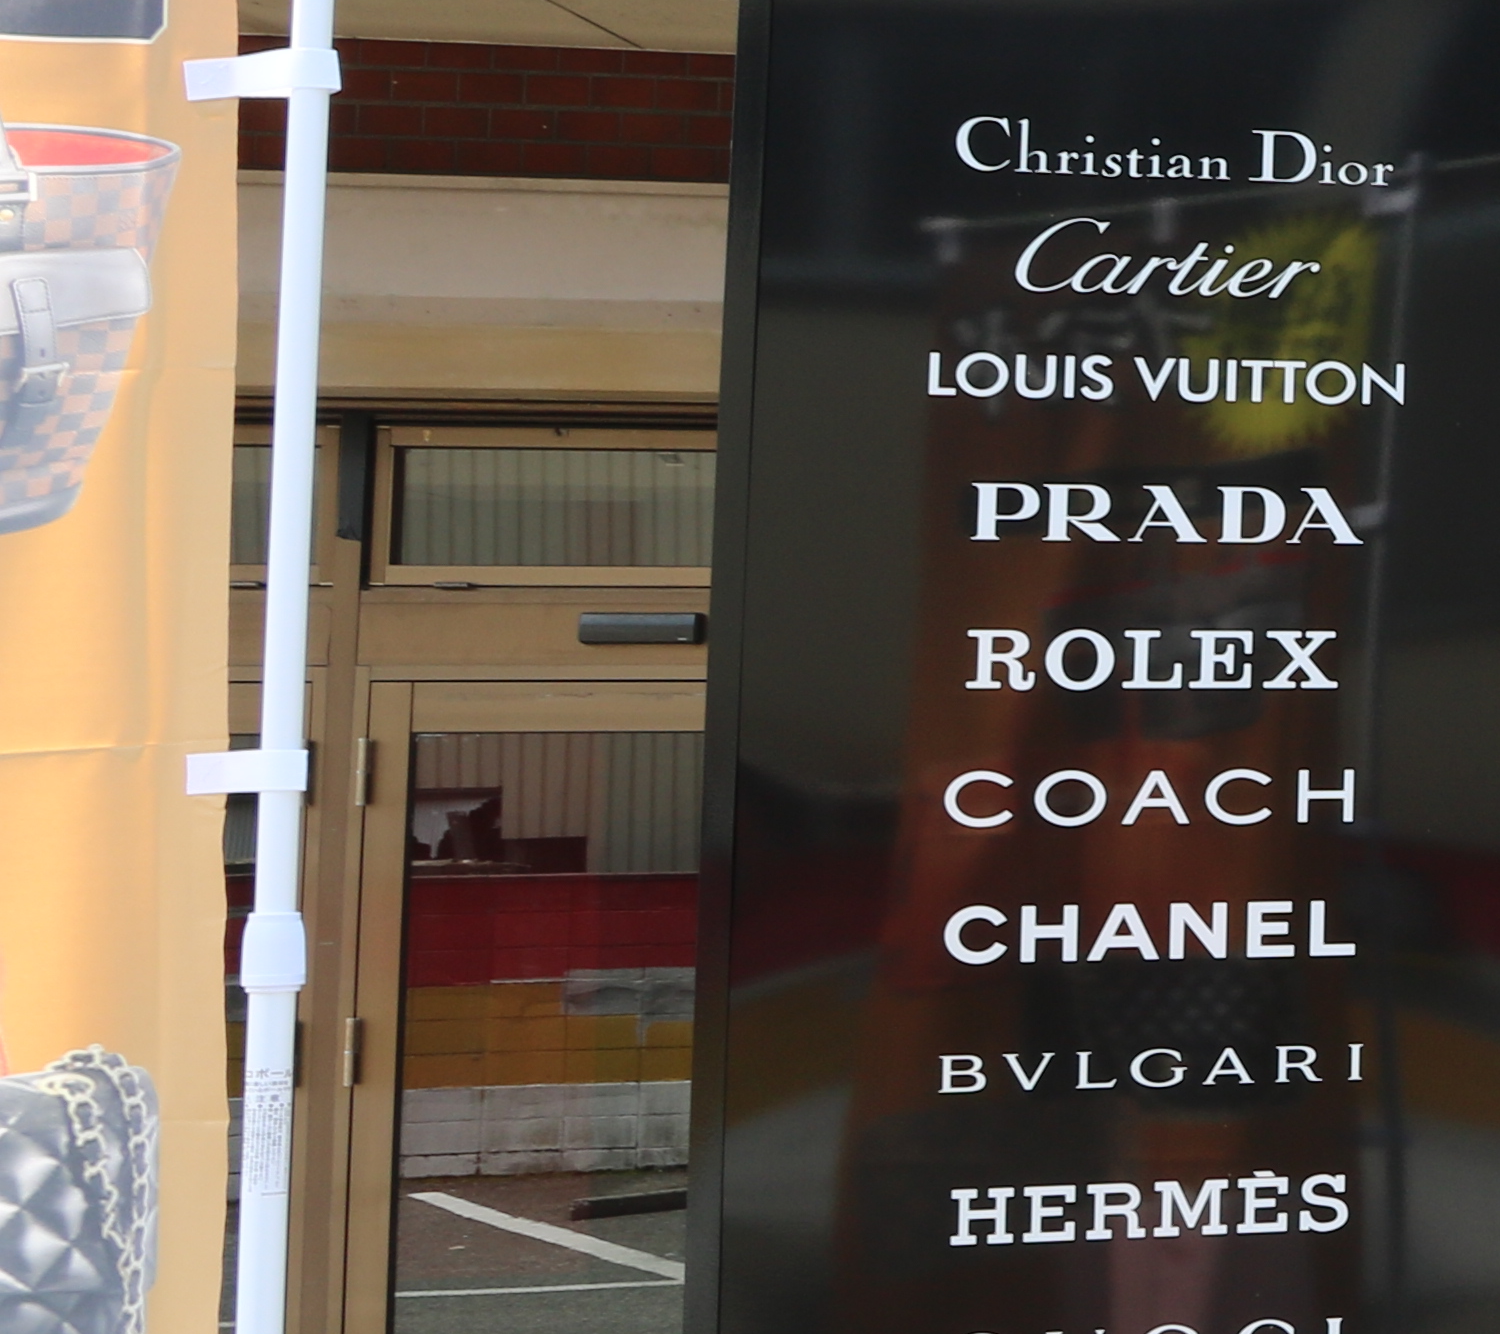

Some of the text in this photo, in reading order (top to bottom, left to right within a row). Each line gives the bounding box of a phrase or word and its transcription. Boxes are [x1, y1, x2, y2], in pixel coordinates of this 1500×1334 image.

[955, 116, 1394, 188] Christian Dior
[1014, 217, 1320, 299] Cartier
[927, 352, 1406, 406] LOUIS VUITTON
[970, 483, 1364, 545] PRADA
[965, 629, 1338, 692] ROLEX
[943, 769, 1356, 828] COACH
[943, 900, 1357, 965] CHANEL
[937, 1044, 1364, 1094] BVLGARI
[948, 1170, 1349, 1247] HERMÈS
